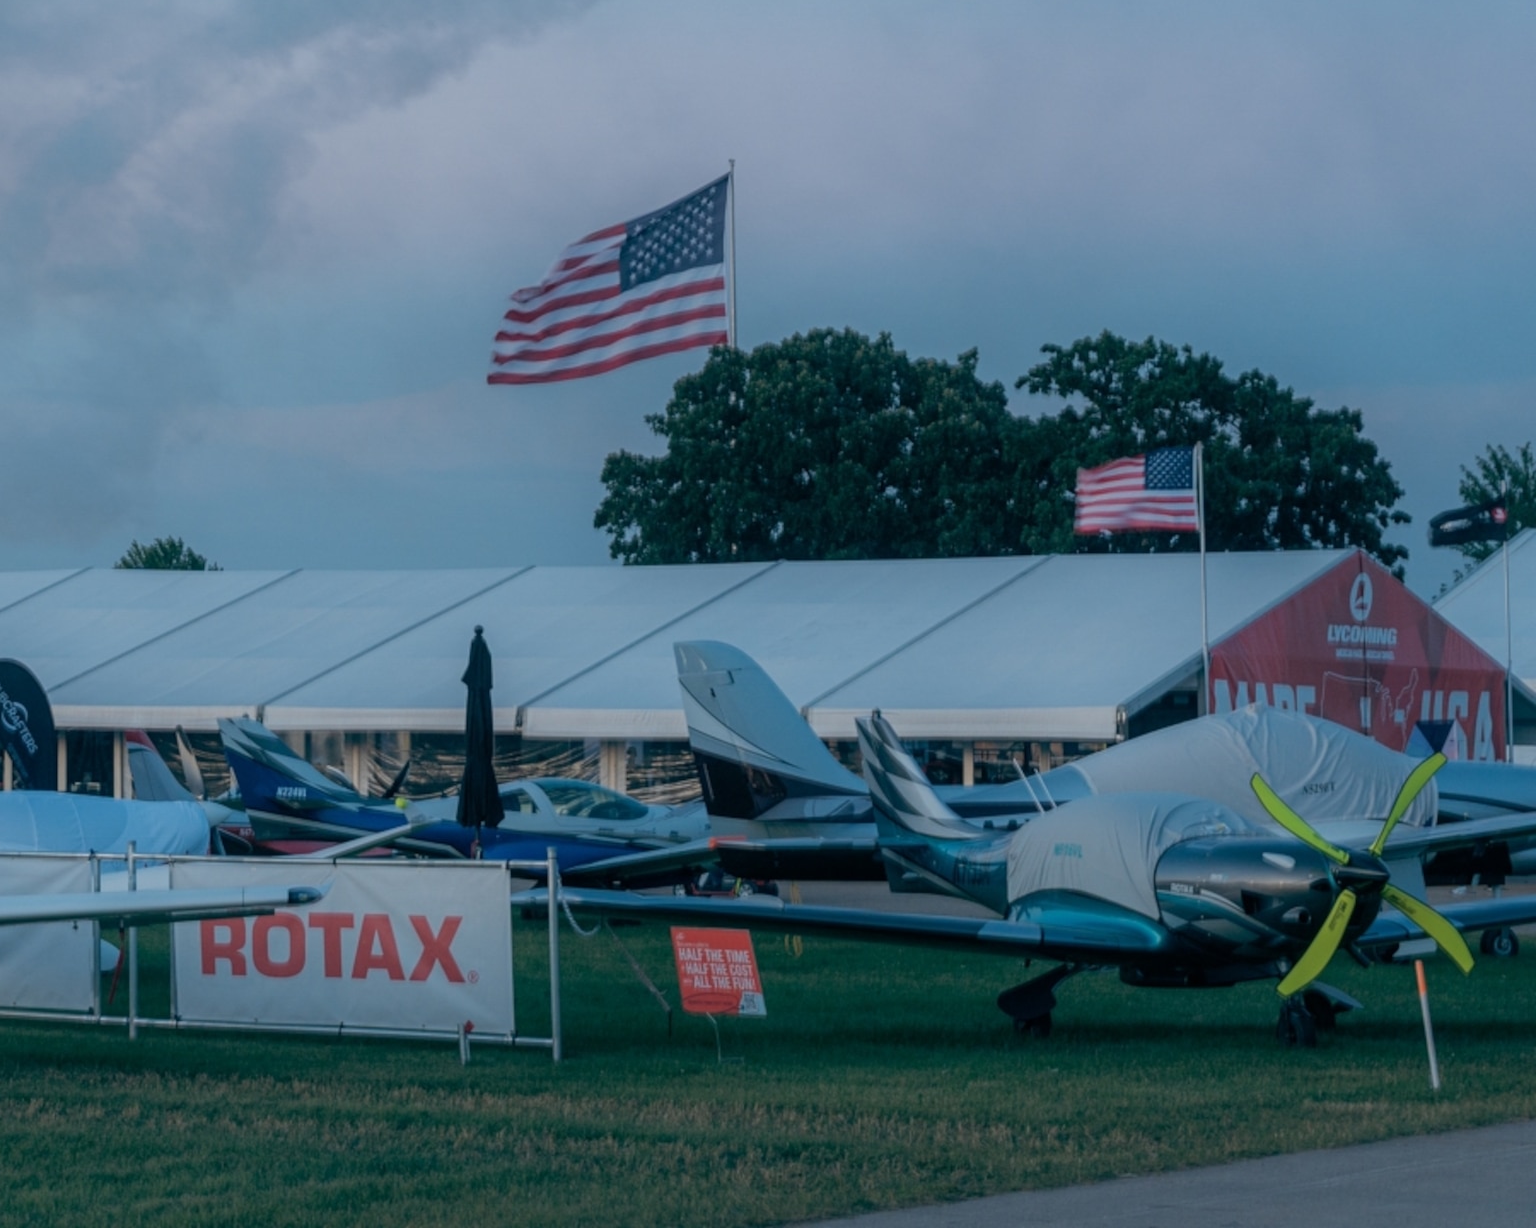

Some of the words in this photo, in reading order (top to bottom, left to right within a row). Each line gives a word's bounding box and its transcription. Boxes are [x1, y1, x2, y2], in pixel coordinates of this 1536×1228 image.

[1328, 624, 1398, 645] LYCOMING
[201, 912, 466, 983] ROTAX
[679, 948, 703, 961] HALF
[705, 949, 725, 963] THE
[725, 950, 751, 964] TIME
[686, 962, 709, 975] HALF
[710, 963, 729, 977] THE
[729, 964, 753, 978] COST
[694, 975, 712, 989] ALL
[712, 976, 732, 990] THE
[733, 977, 757, 992] FUN!
